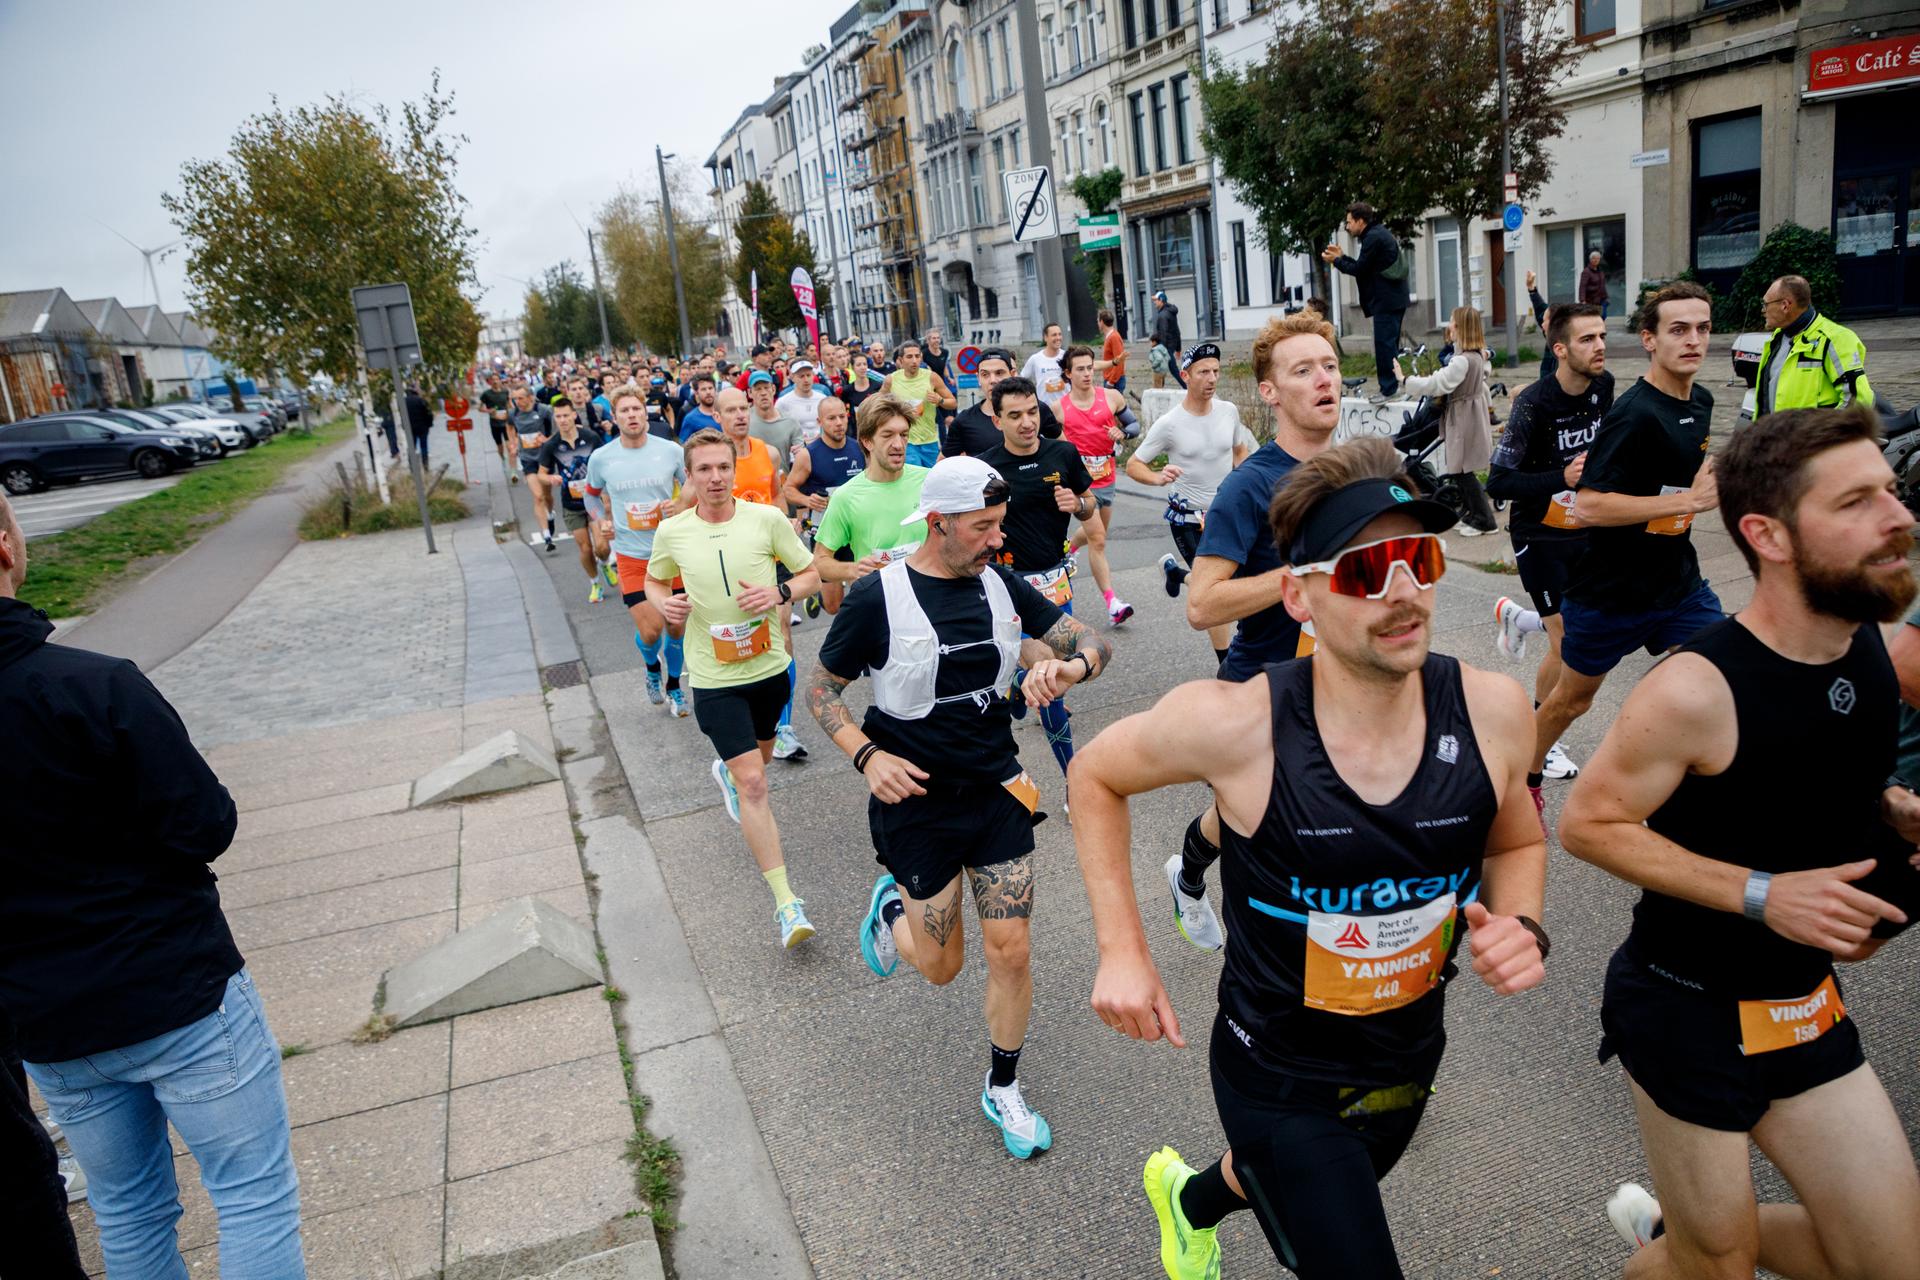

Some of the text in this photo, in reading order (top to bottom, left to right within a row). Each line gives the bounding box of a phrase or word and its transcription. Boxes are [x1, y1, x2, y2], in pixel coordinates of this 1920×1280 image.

[1856, 46, 1902, 72] Café
[1014, 171, 1041, 184] ZONE
[735, 638, 752, 648] RIK
[1290, 867, 1470, 914] kuraray
[1378, 916, 1413, 929] Port of
[1377, 925, 1420, 939] Antwerp
[1377, 937, 1410, 949] Bruges
[1341, 948, 1433, 980] YANNICK
